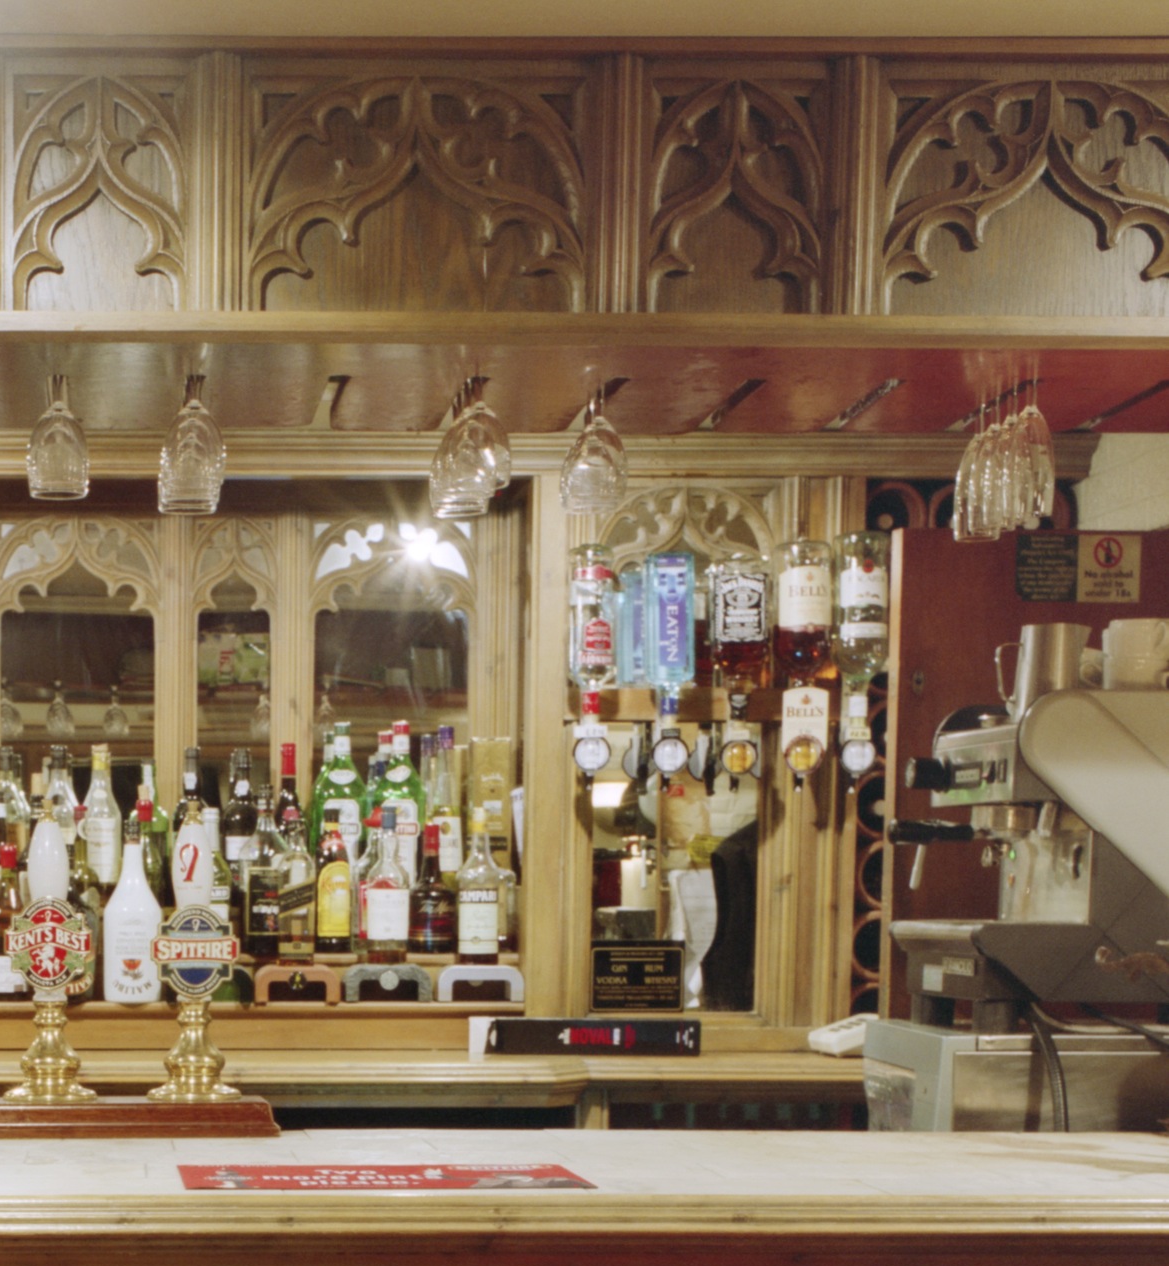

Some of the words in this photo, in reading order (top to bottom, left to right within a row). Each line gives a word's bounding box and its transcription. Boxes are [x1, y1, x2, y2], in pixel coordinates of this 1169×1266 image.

[1084, 570, 1098, 578] No
[1100, 569, 1134, 578] alcohol
[1085, 589, 1111, 597] under
[1116, 589, 1132, 597] 18s
[785, 706, 825, 718] BELL'S
[55, 926, 88, 952] BEST
[157, 940, 233, 960] SPITFIRE
[596, 976, 628, 985] VODKA
[112, 979, 153, 996] MALIBU
